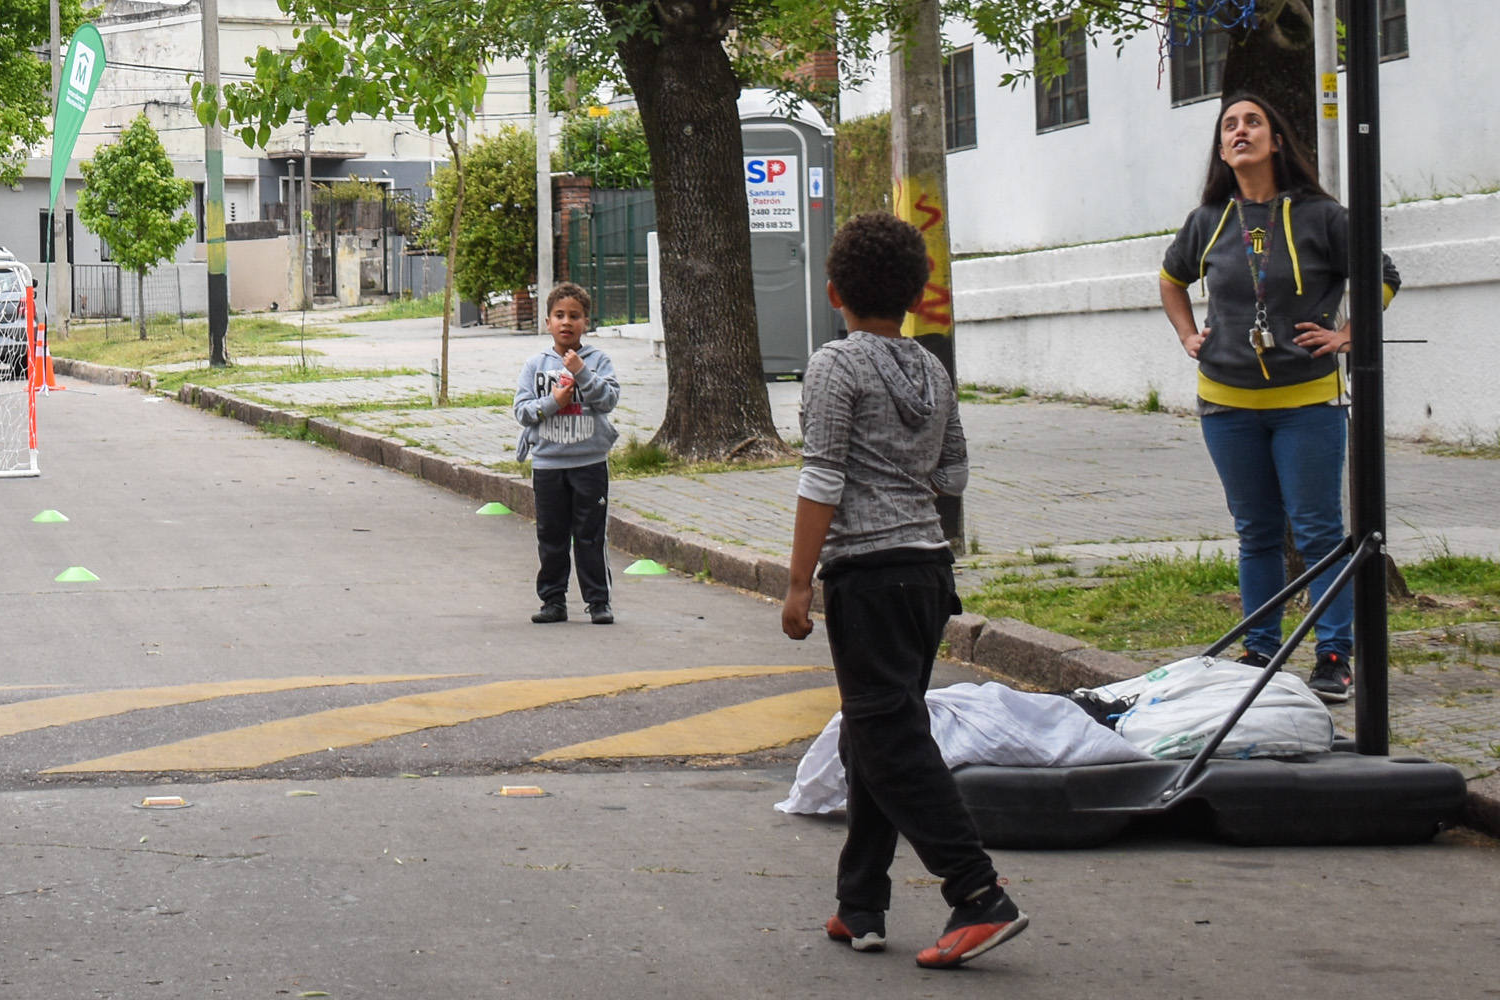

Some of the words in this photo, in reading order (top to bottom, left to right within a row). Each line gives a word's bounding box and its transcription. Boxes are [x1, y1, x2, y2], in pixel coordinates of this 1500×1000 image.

[747, 160, 786, 183] SP
[750, 208, 770, 216] 2480
[539, 415, 594, 445] MAGICLAND
